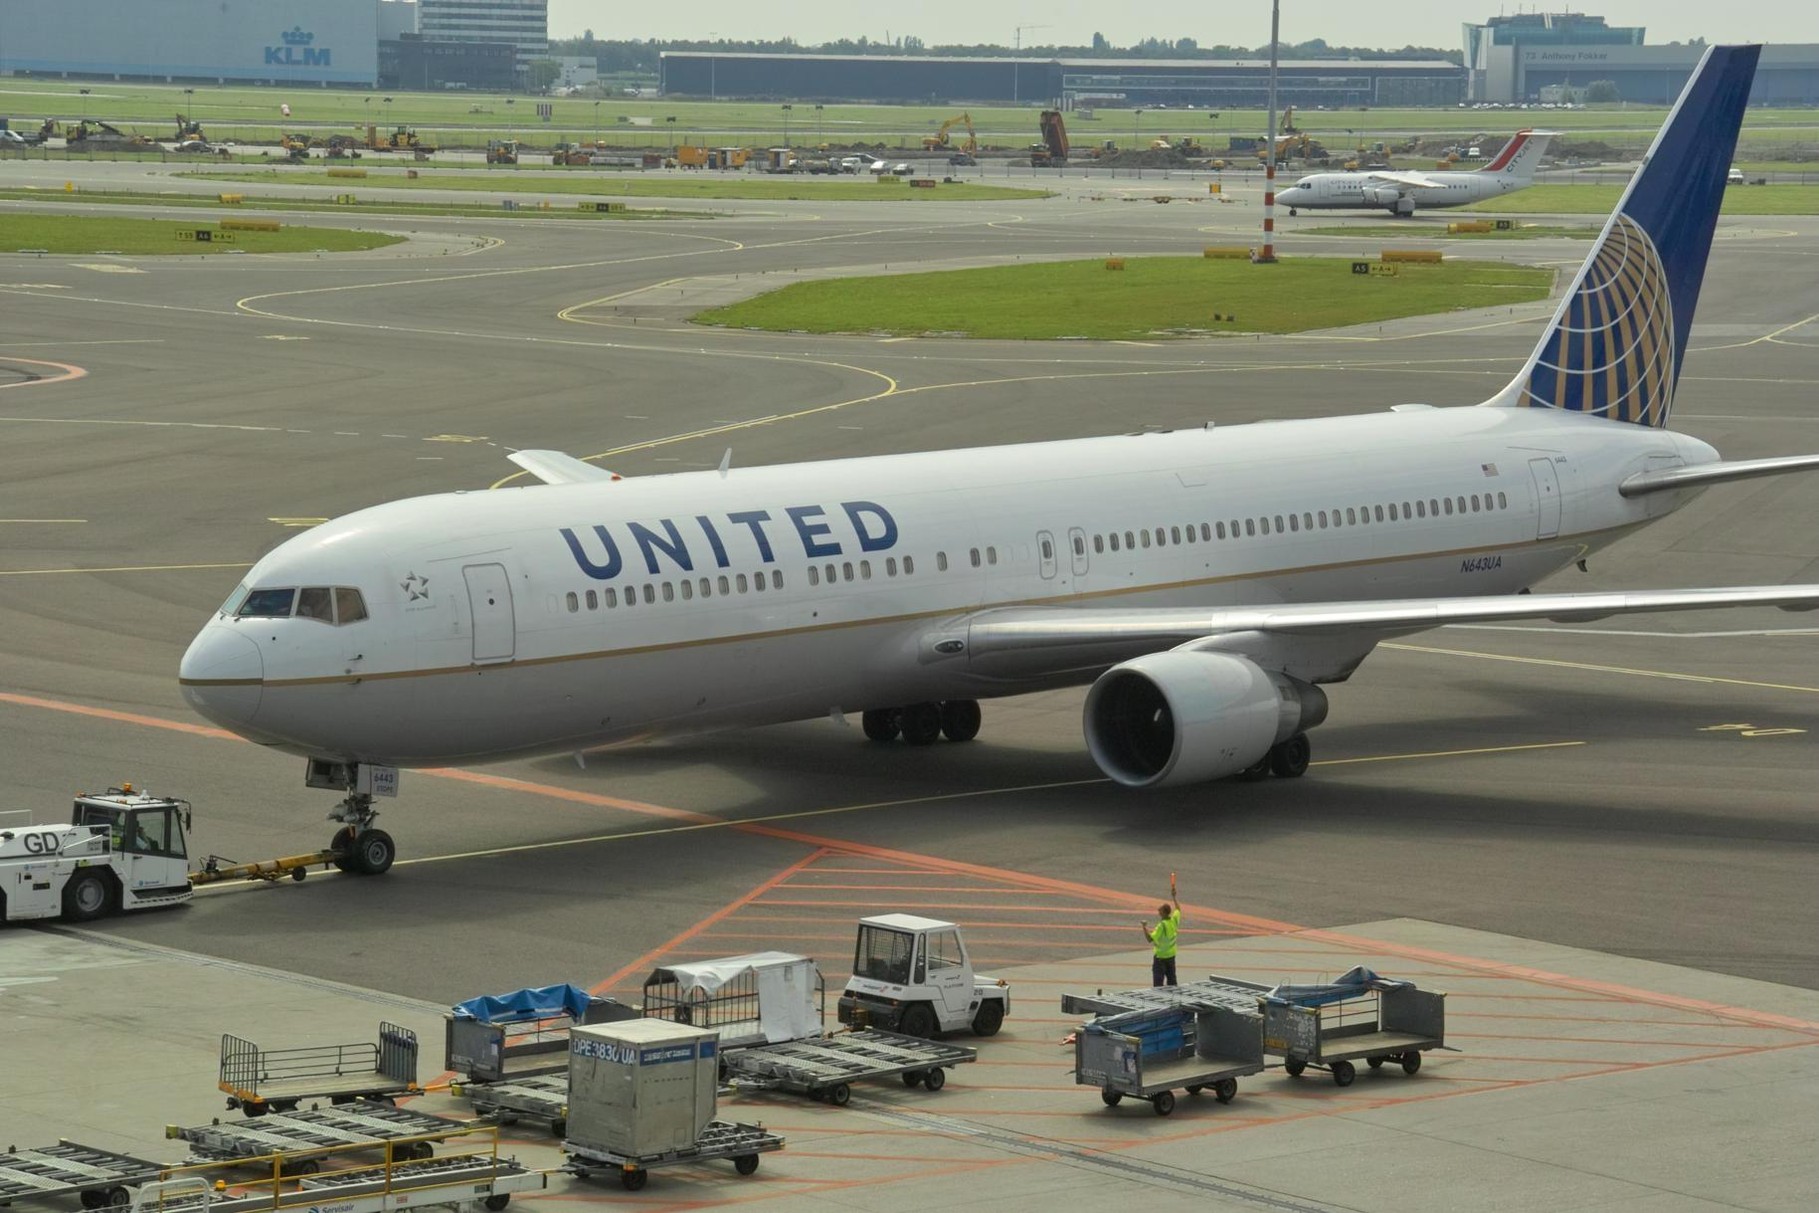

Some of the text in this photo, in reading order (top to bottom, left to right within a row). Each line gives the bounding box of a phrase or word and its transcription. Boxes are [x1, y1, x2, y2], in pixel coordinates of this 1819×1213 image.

[265, 47, 331, 66] KLM
[1541, 52, 1577, 62] Anthony
[1578, 51, 1608, 61] Fokker
[1507, 139, 1533, 173] CITYJET
[1355, 264, 1367, 273] A5
[559, 501, 899, 580] UNITED
[1460, 556, 1502, 573] N643UA
[374, 772, 394, 783] 6443
[24, 832, 60, 853] GD
[973, 988, 984, 996] 20
[620, 1048, 637, 1066] UA
[322, 1203, 355, 1213] Servisair
